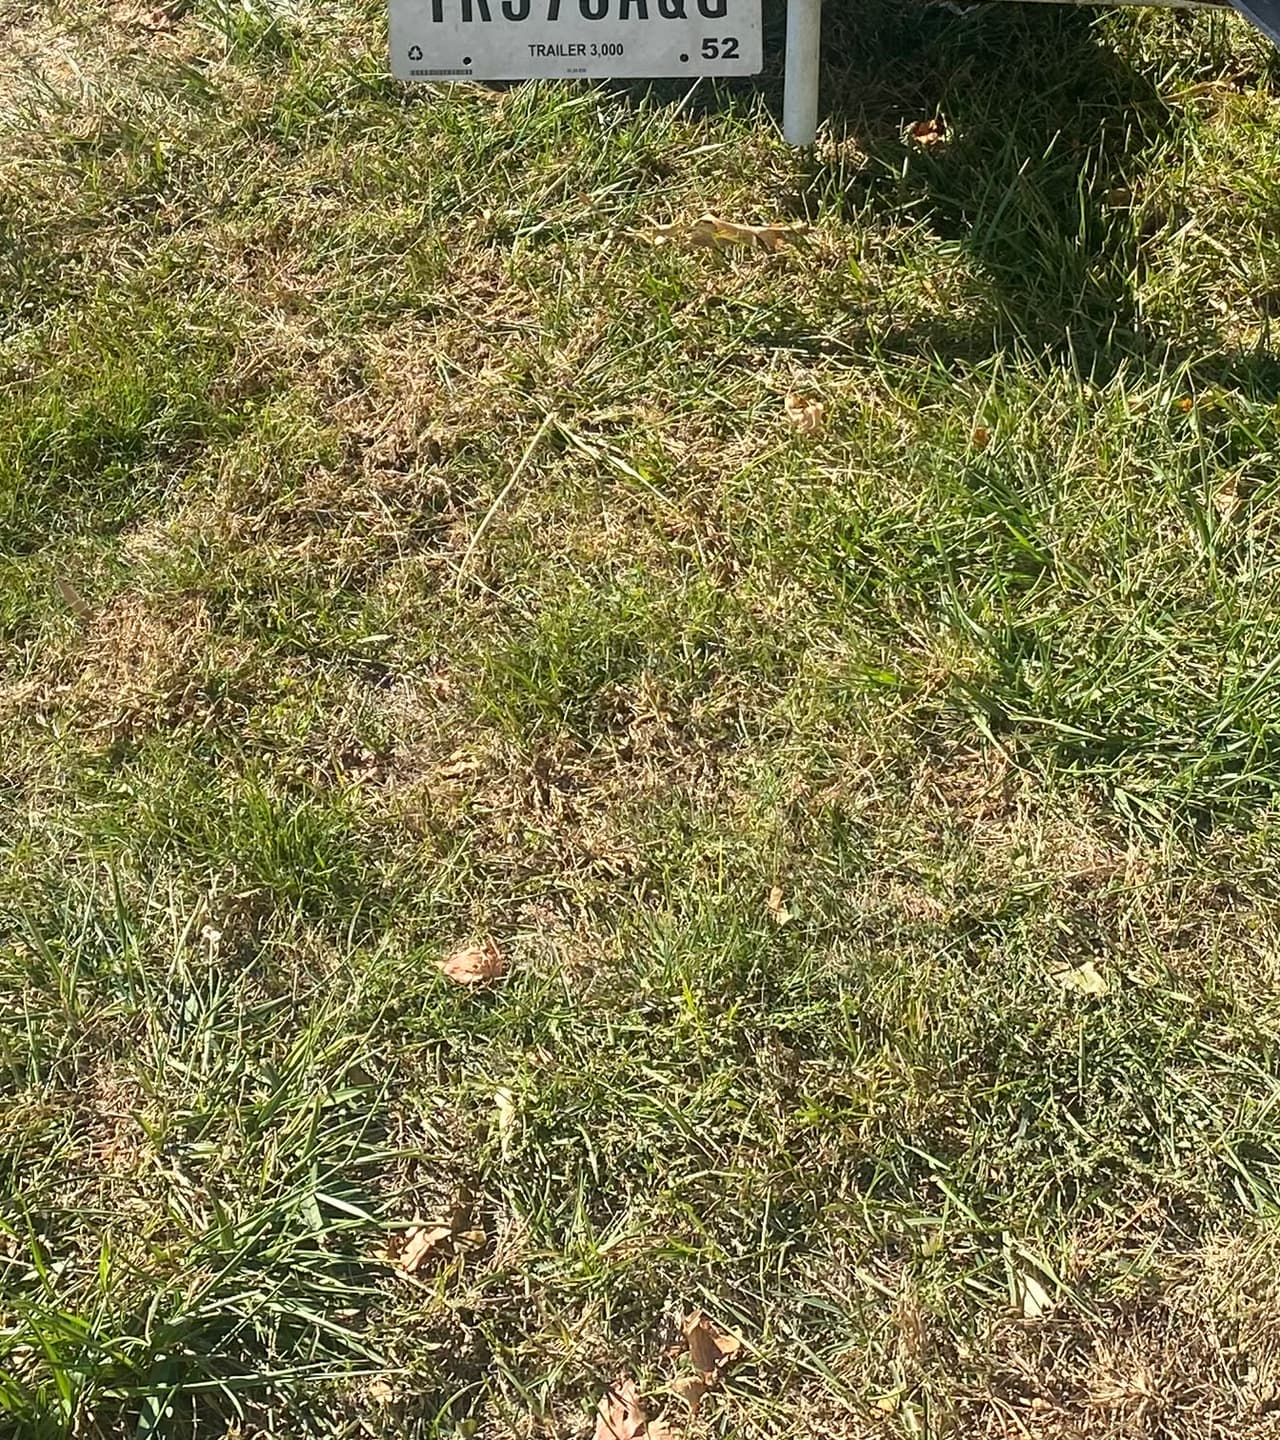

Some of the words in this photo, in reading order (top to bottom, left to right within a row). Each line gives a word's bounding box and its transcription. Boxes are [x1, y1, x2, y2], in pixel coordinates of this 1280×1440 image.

[527, 43, 587, 57] TRAILER
[590, 43, 624, 58] 3,000
[701, 37, 740, 60] 52
